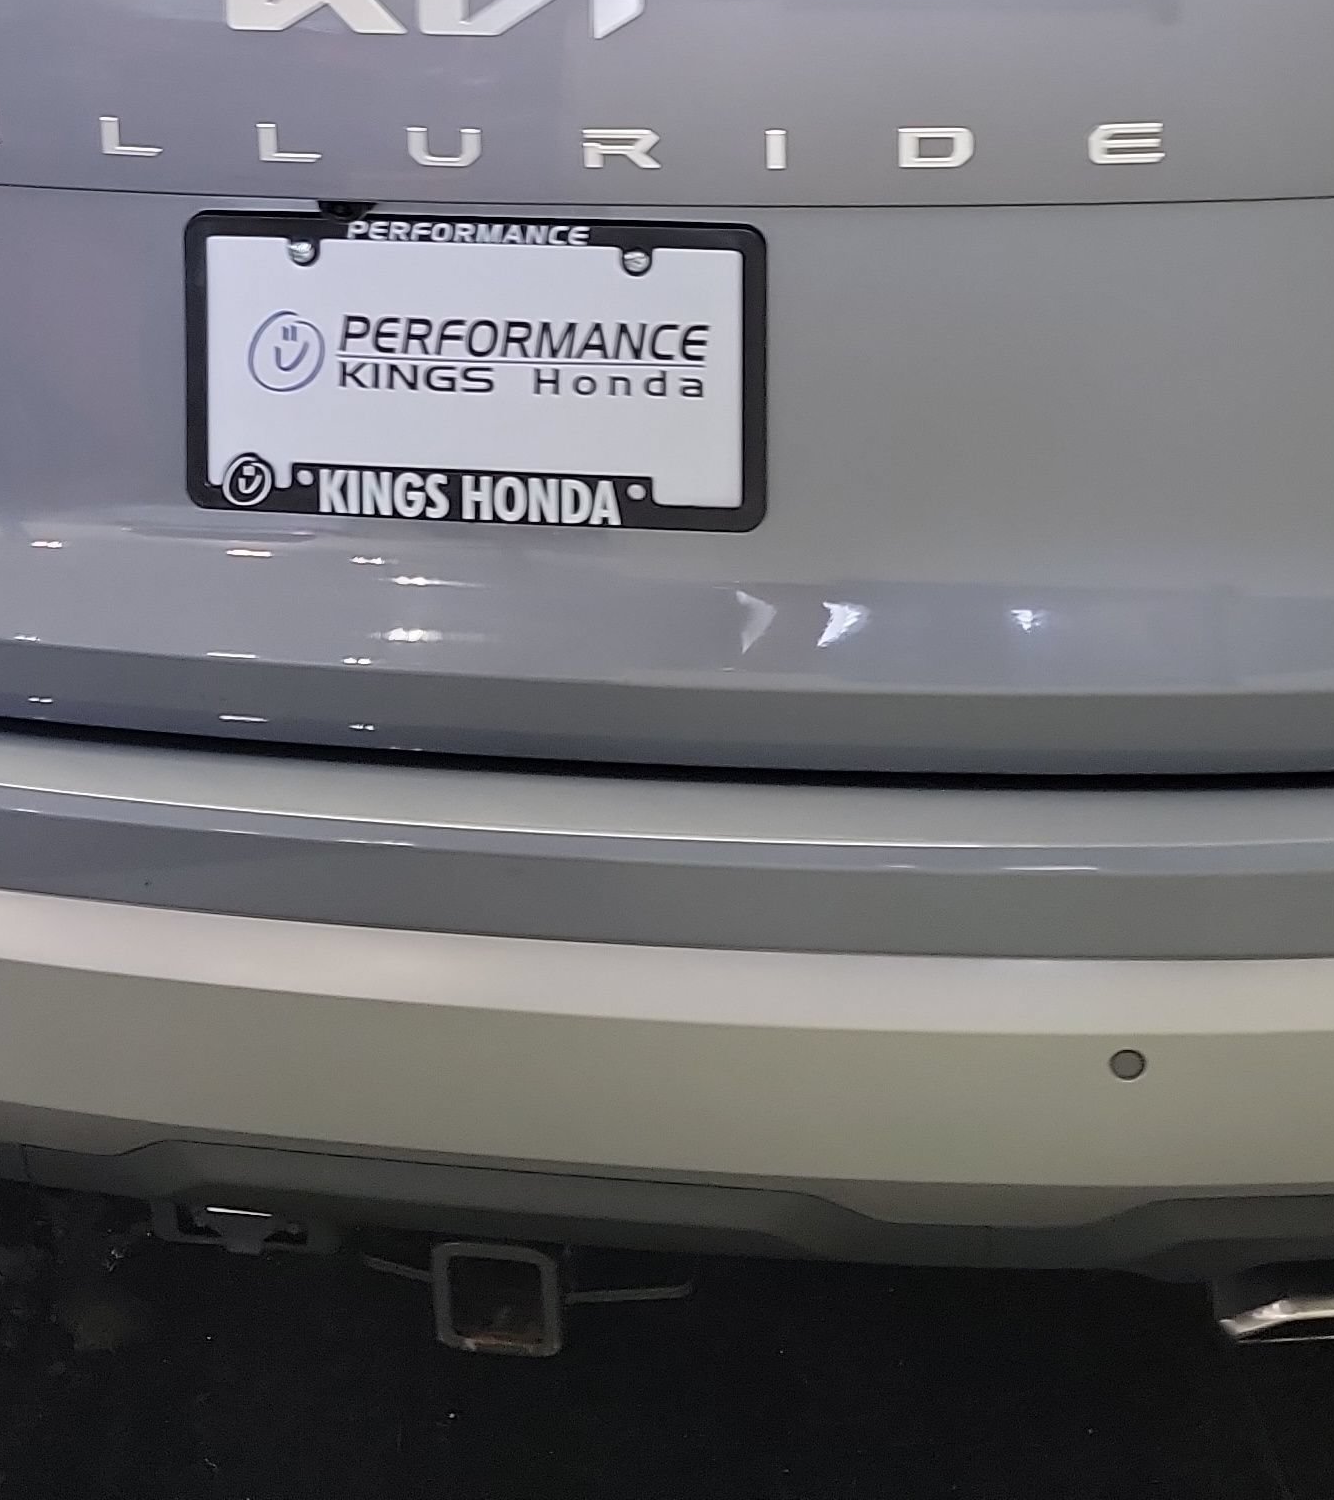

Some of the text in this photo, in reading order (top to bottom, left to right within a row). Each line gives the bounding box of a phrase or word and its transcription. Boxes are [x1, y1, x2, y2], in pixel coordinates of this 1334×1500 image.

[348, 220, 591, 246] PERFORMANCE
[340, 314, 710, 361] PERFORMANCE
[338, 362, 705, 398] KINGS Honda
[318, 468, 623, 527] KINGS HONDA
